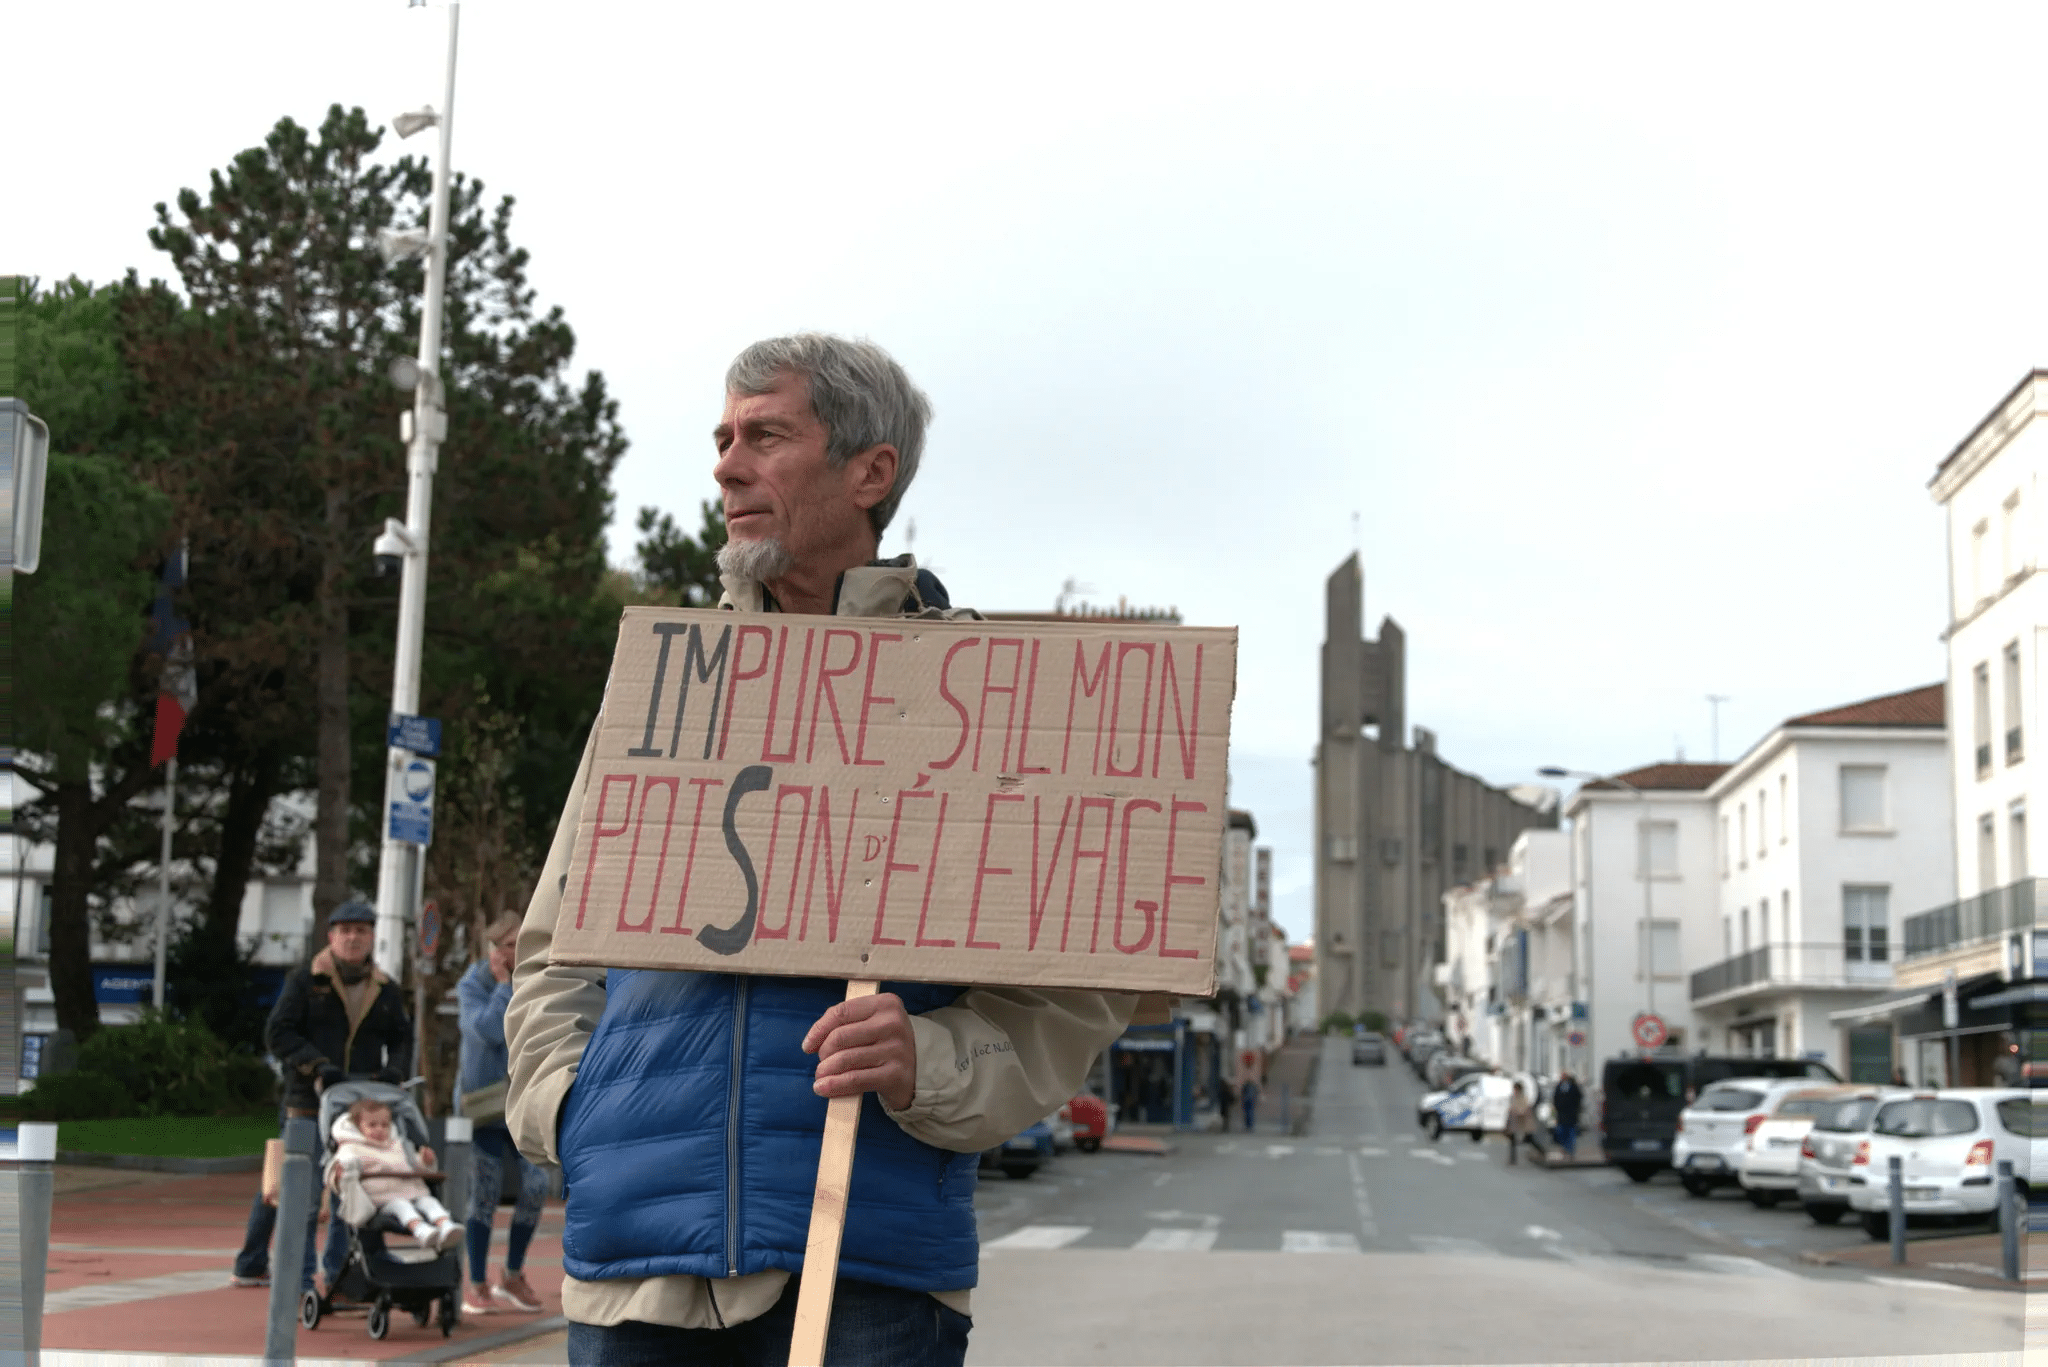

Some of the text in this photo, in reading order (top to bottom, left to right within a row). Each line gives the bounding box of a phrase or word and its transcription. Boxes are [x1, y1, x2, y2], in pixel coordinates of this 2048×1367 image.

[627, 622, 1204, 780] IMPURE SALMON
[575, 765, 860, 956] POISON
